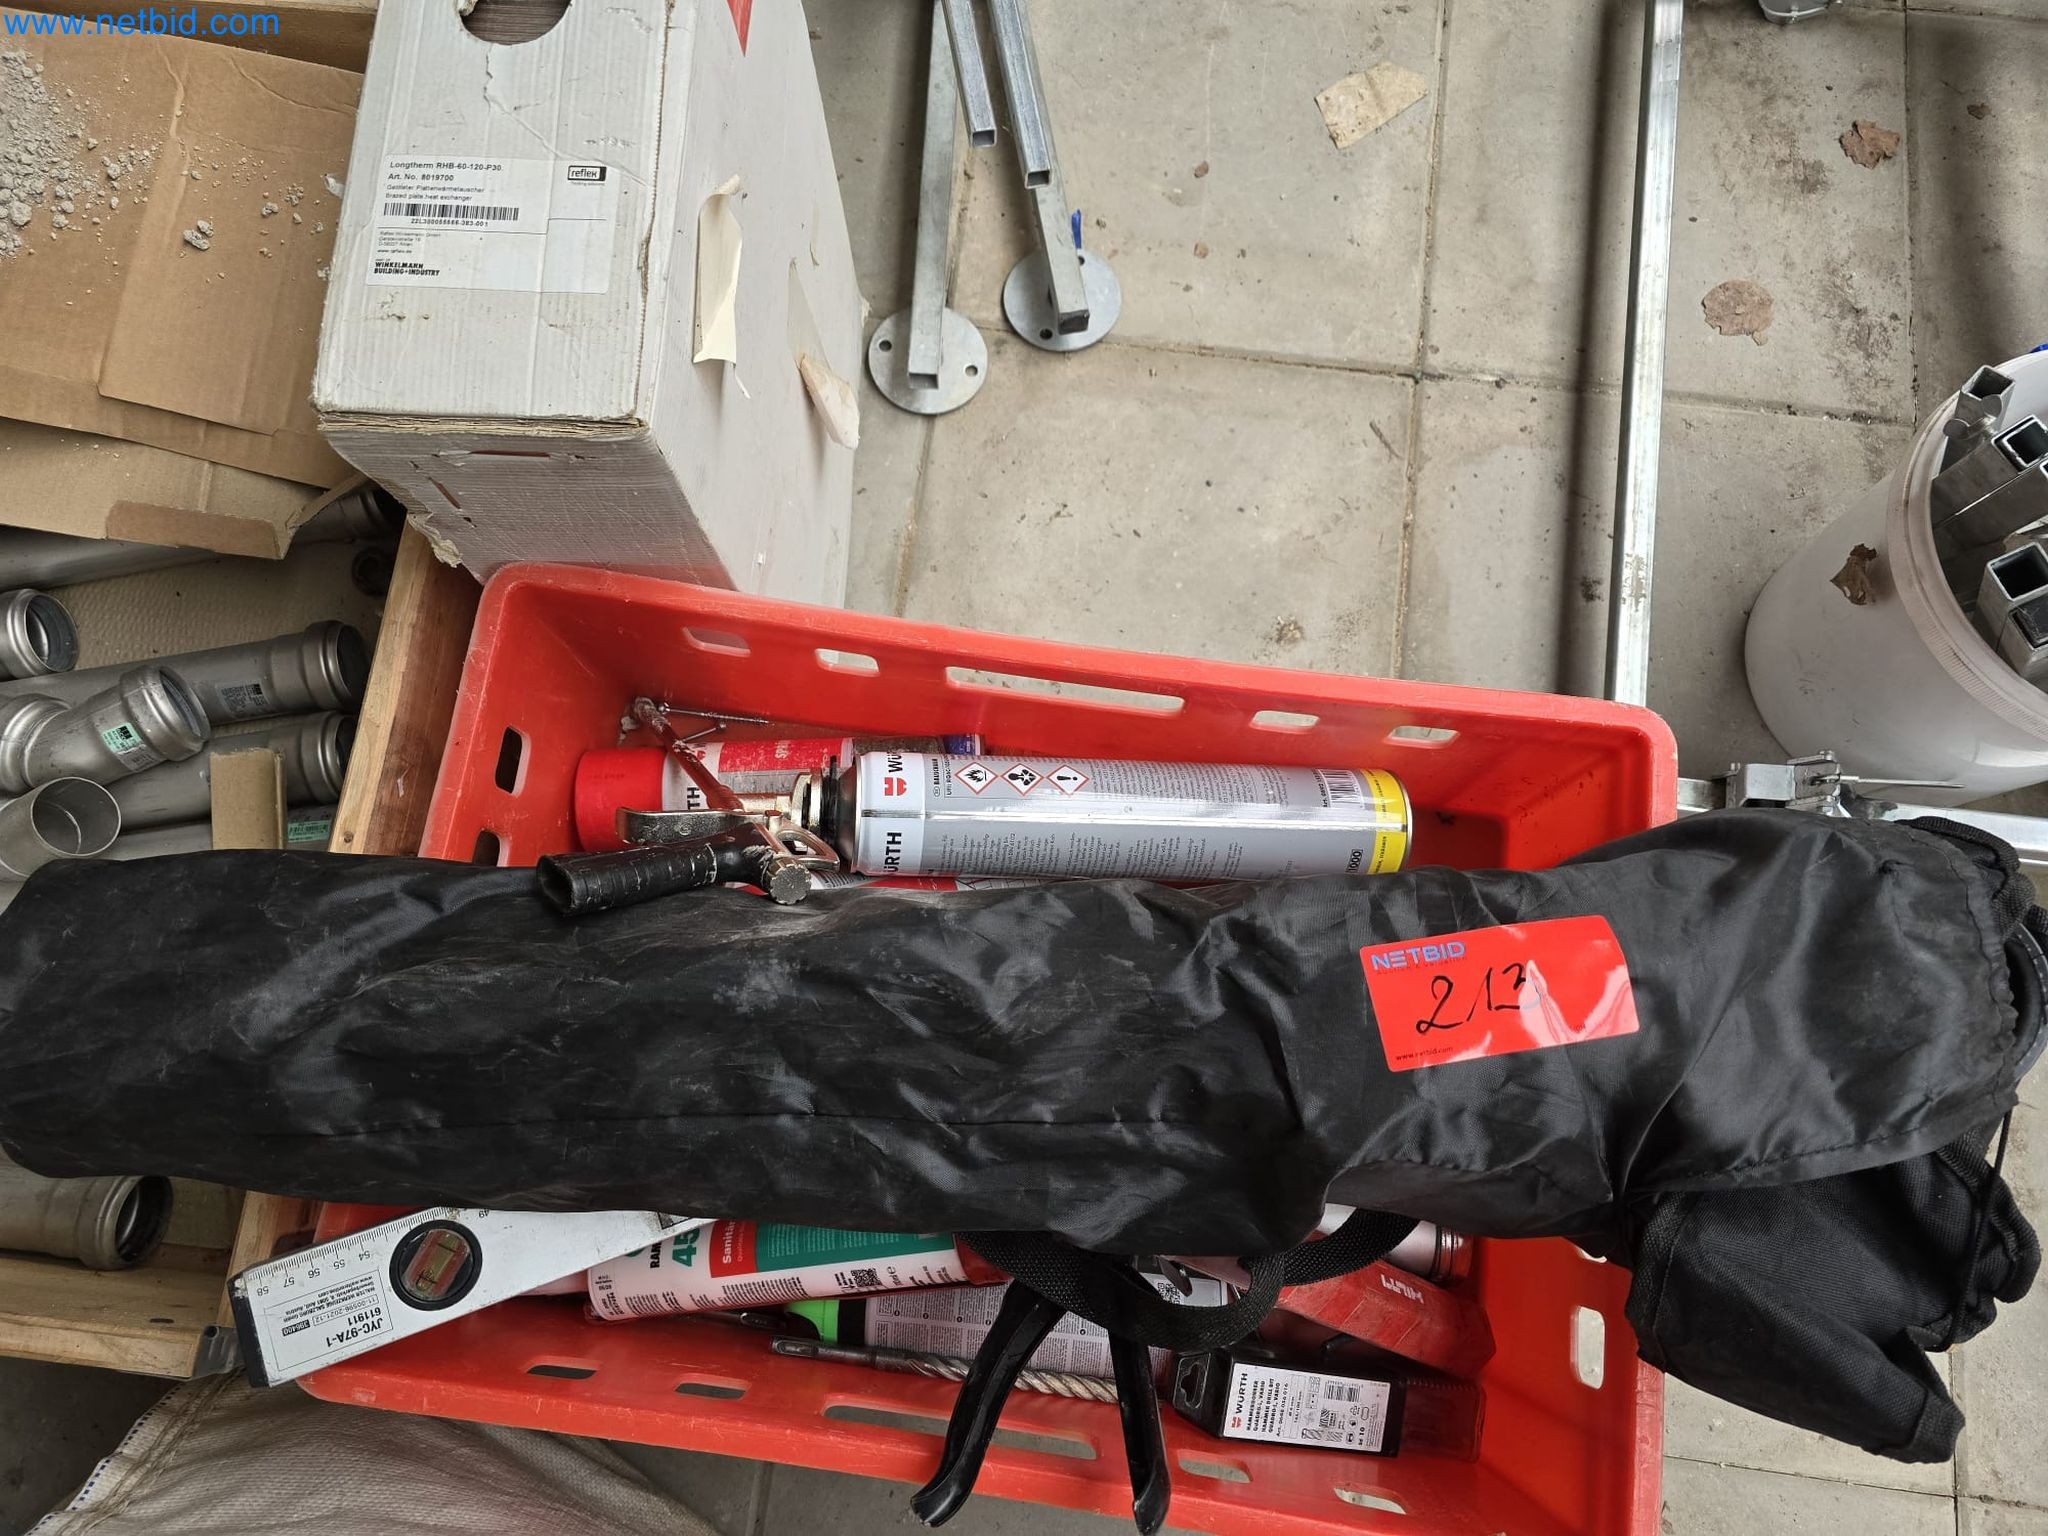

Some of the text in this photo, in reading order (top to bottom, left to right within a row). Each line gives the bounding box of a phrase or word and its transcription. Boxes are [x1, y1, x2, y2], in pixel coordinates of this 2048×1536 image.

[389, 161, 502, 172] Longtherm RHB-60-120-P30
[387, 173, 402, 181] Art.
[404, 173, 418, 181] No.
[571, 168, 597, 178] reflex
[439, 194, 473, 202] exchanger
[375, 261, 424, 269] WINKELMANN
[373, 267, 440, 276] BUILDING+INDUSTRY
[1371, 941, 1466, 971] NETBID
[358, 1250, 371, 1262] 54
[333, 1258, 346, 1271] 55
[307, 1267, 321, 1279] 56
[283, 1276, 295, 1288] 57
[256, 1285, 270, 1297] 58
[1380, 1273, 1424, 1304] HILTI
[285, 1304, 304, 1316] Austria
[347, 1306, 382, 1326] 611911
[326, 1317, 384, 1348] JYC-97A-1
[1235, 1372, 1248, 1414] WÜRTH
[1261, 1406, 1270, 1433] HAMMER
